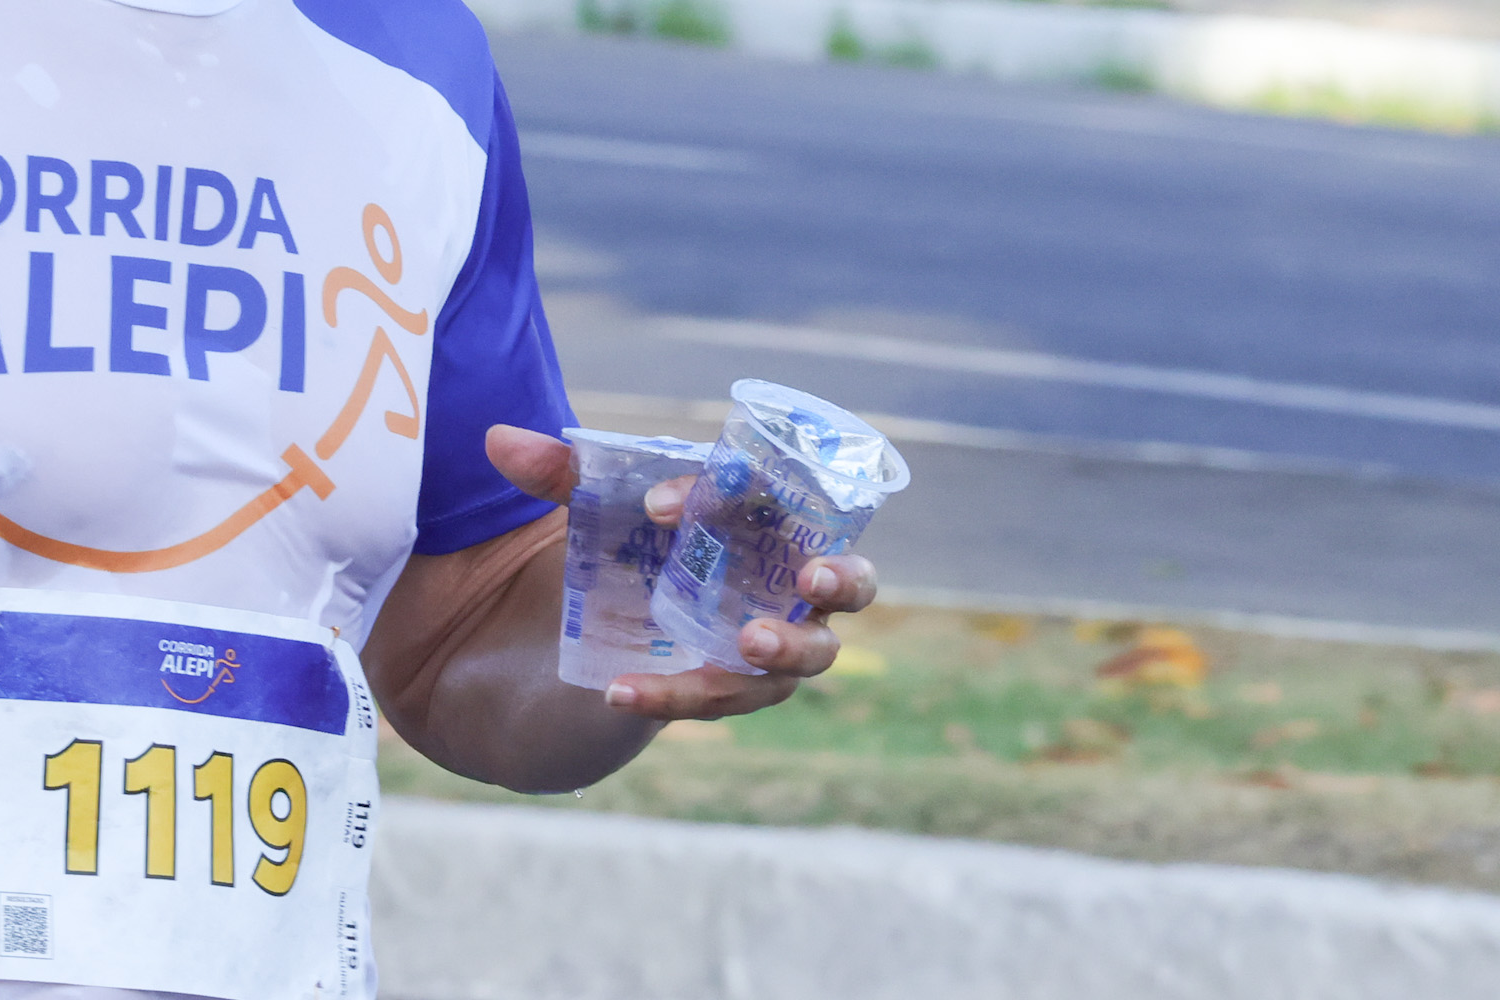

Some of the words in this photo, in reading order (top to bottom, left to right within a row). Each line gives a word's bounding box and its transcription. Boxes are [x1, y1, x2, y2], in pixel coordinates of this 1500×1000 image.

[158, 639, 215, 658] CORRIDA
[160, 653, 215, 679] ALEPI
[356, 682, 373, 729] 1119
[43, 737, 308, 897] 1119
[343, 802, 354, 843] FRUTAS
[352, 800, 371, 849] 1119
[345, 921, 358, 969] 1119
